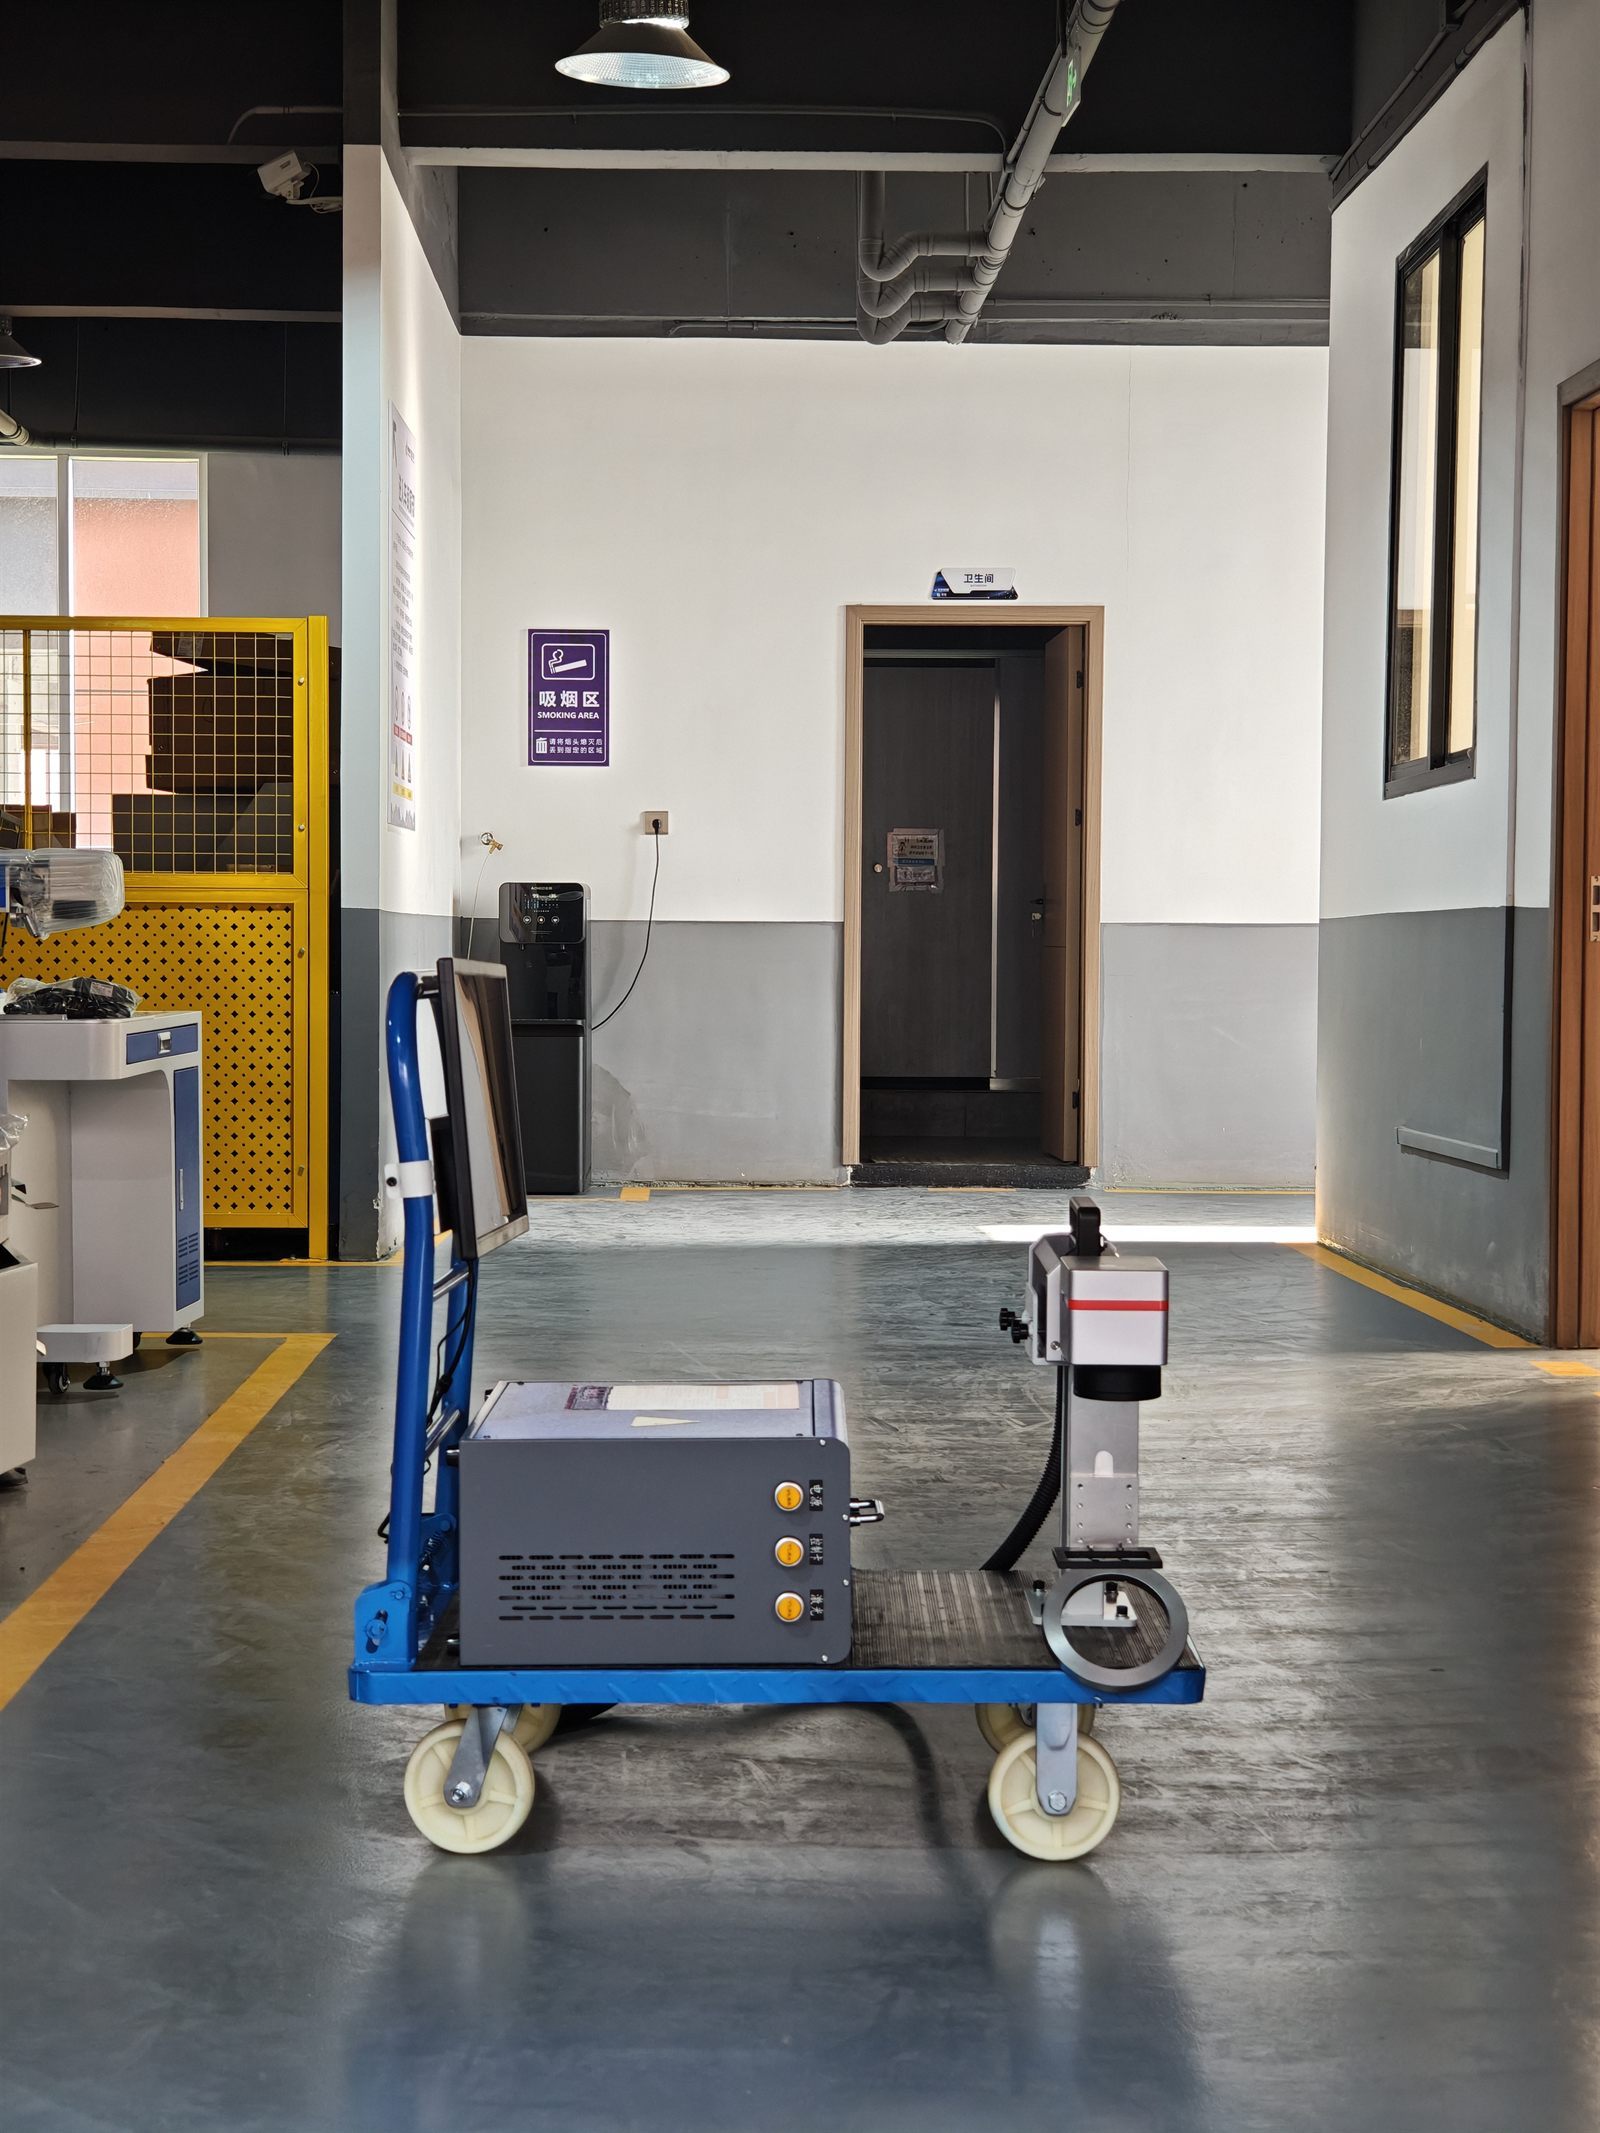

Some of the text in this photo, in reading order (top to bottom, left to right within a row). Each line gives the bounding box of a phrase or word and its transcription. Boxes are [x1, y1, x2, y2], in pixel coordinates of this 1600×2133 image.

[963, 573, 994, 584] 卫生间
[538, 690, 600, 708] 吸烟区
[537, 711, 600, 720] SMOKING AREA
[810, 1484, 823, 1507] 电源
[810, 1537, 823, 1561] 控制卡
[810, 1594, 823, 1616] 激光
